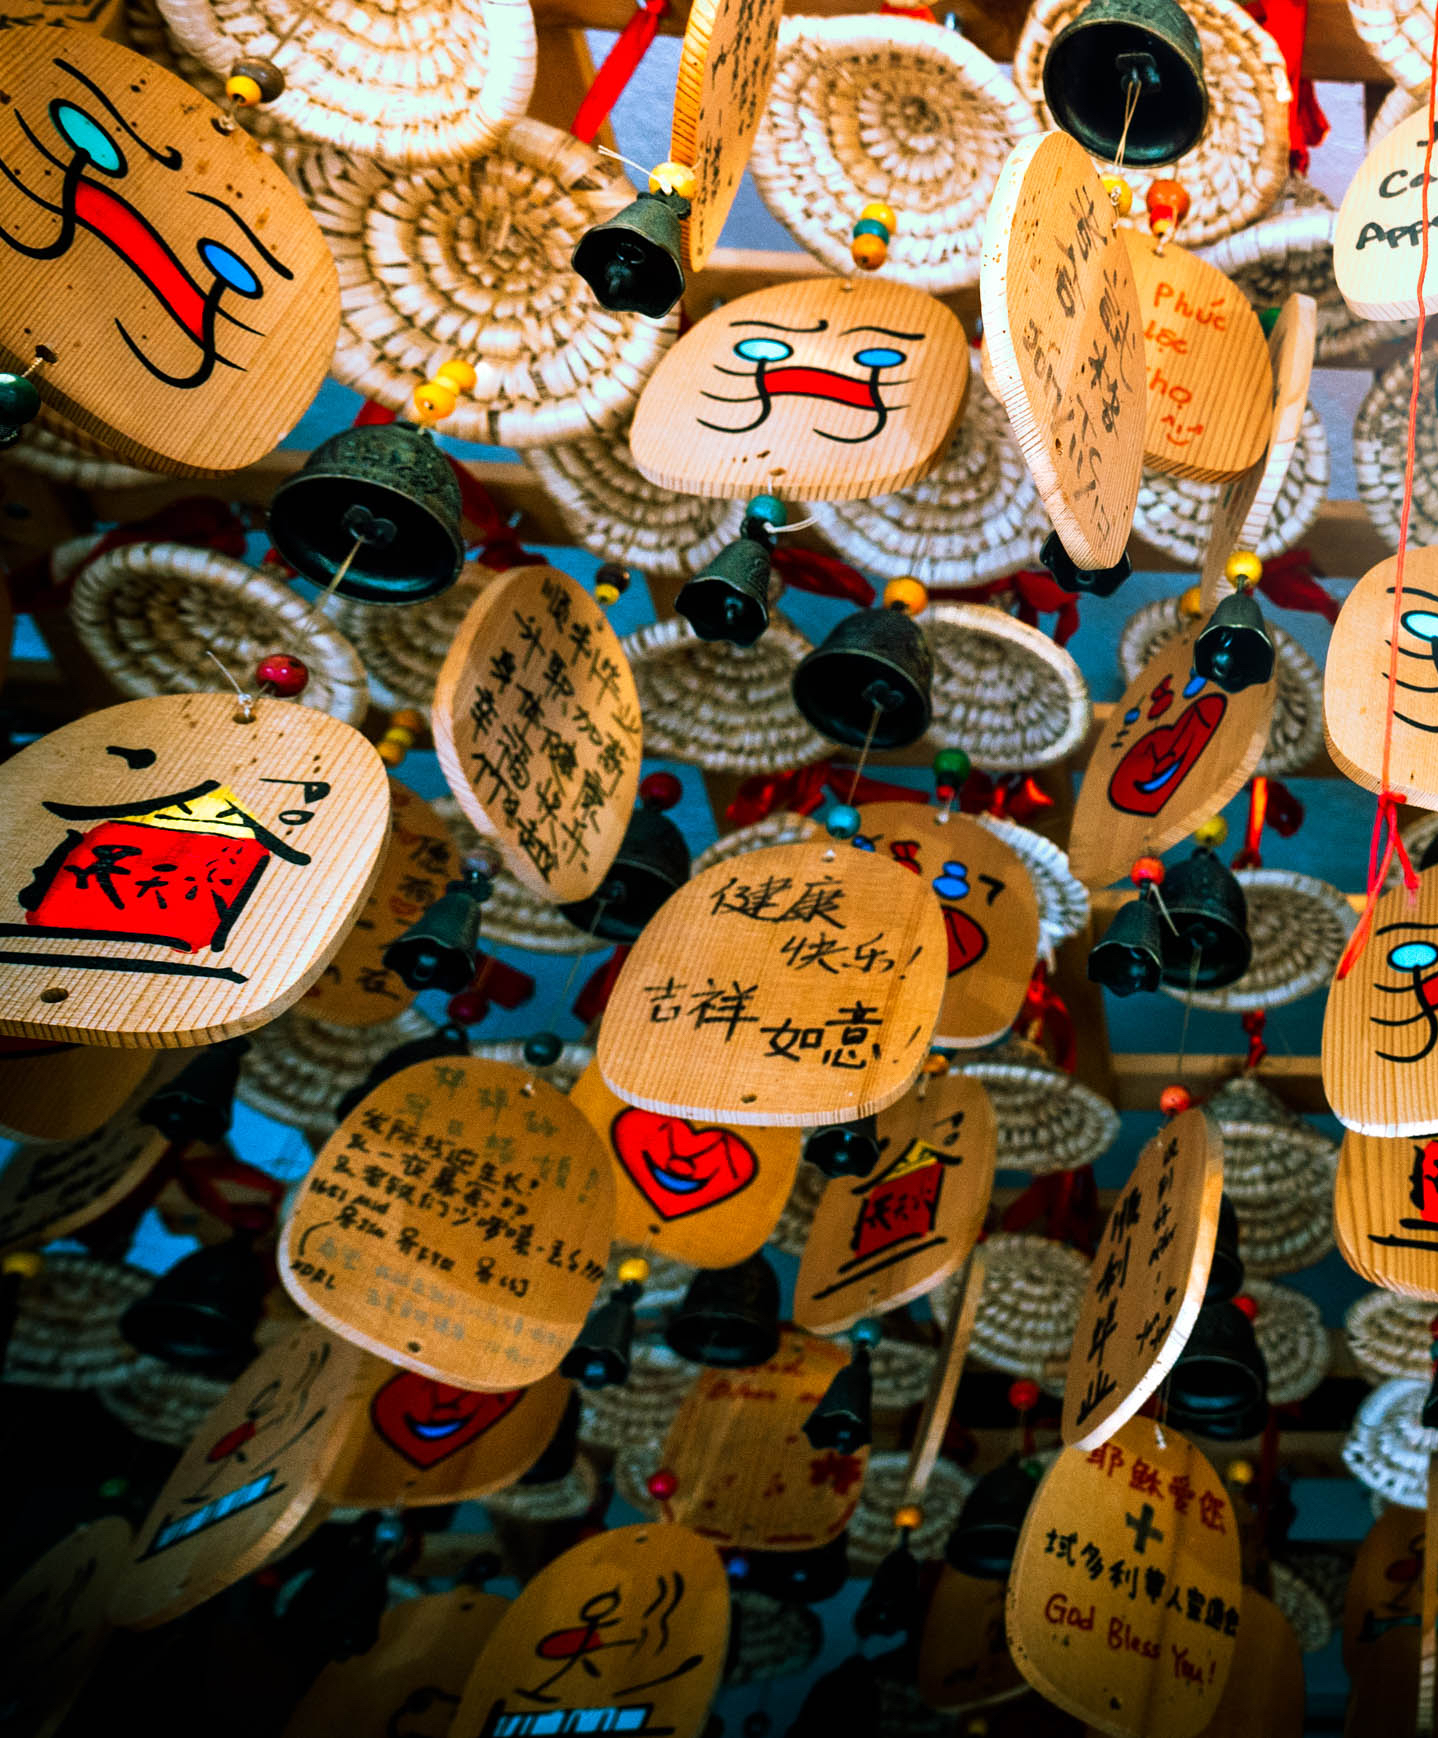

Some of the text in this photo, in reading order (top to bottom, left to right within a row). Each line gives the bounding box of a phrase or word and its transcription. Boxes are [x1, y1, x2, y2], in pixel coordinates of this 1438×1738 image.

[1153, 282, 1228, 332] Phúc
[1145, 364, 1193, 411] họ
[709, 875, 846, 930] 健康
[643, 976, 761, 1043] 吉祥
[1045, 1592, 1096, 1631] God
[1107, 1616, 1162, 1660] Bless
